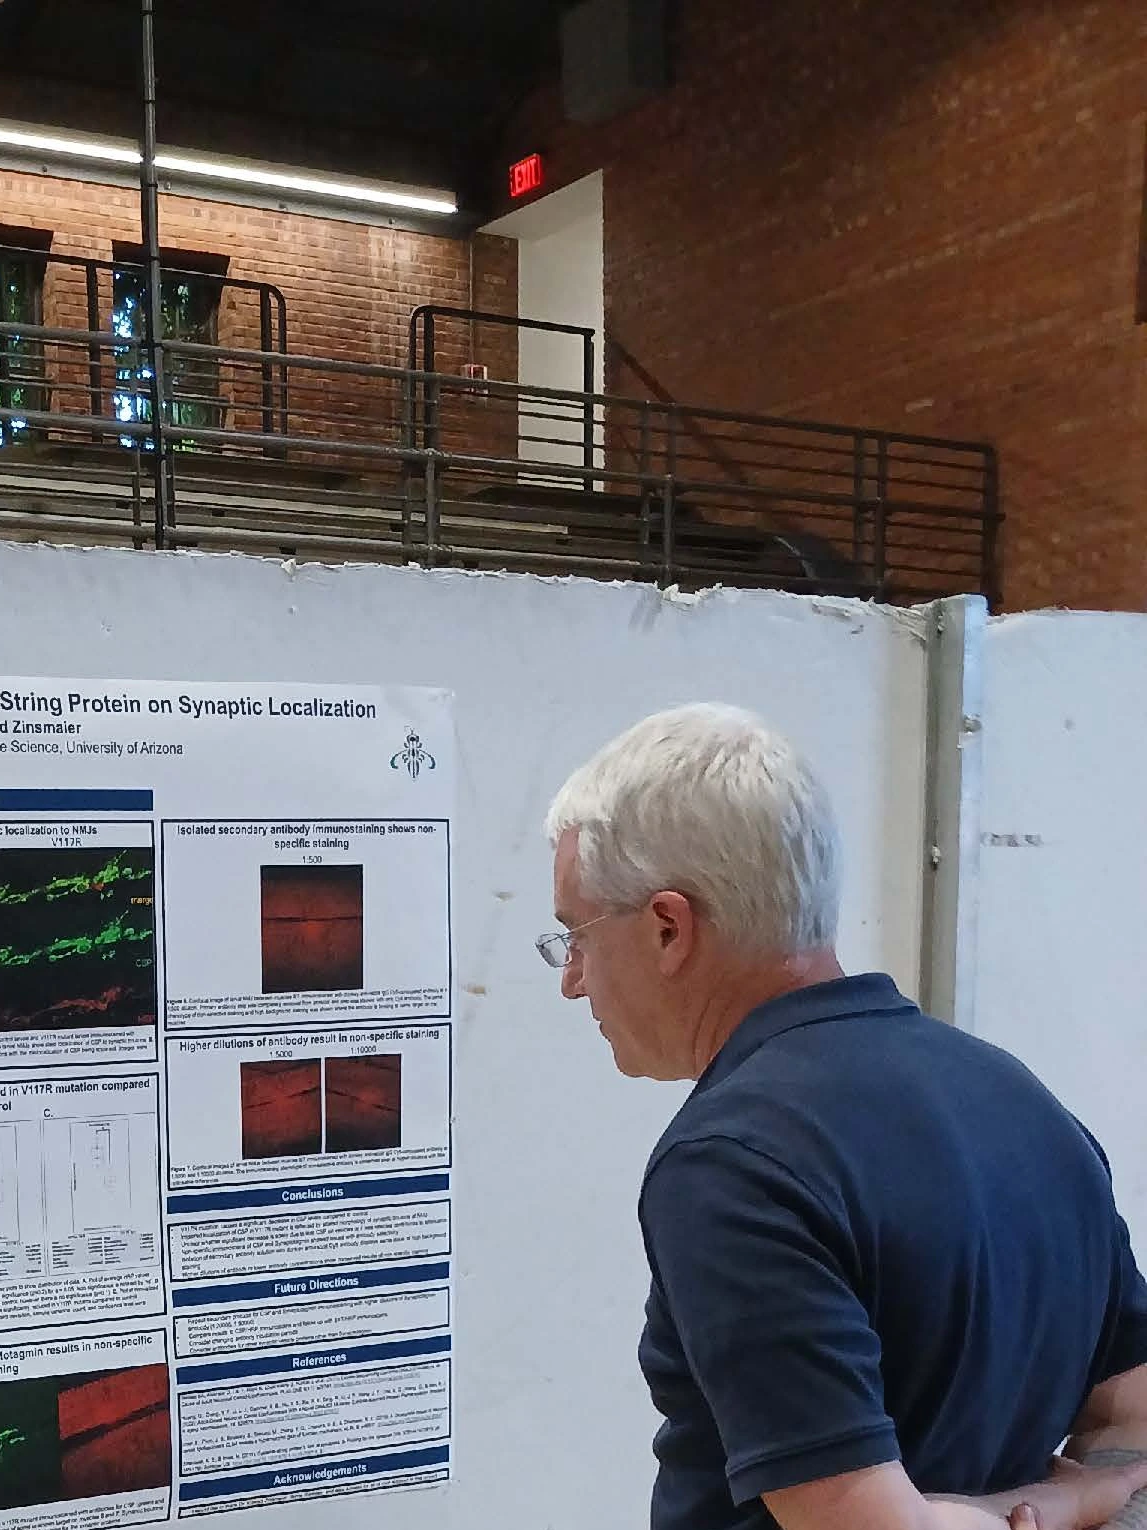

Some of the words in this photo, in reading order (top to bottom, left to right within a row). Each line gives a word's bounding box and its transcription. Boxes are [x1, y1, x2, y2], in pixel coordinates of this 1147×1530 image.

[515, 158, 537, 194] EXIT
[0, 692, 63, 717] String
[68, 693, 141, 714] Protein
[148, 700, 173, 714] on
[178, 695, 263, 719] Synaptic
[269, 697, 377, 719] Localization
[12, 720, 82, 735] Zinsmaier
[11, 740, 63, 756] Science,
[66, 741, 124, 757] University
[127, 741, 139, 755] of
[139, 742, 184, 756] Arizona
[5, 825, 59, 836] localization
[61, 825, 70, 835] to
[72, 825, 98, 836] NMJs
[177, 825, 216, 835] Isolated
[218, 825, 267, 837] secondary
[270, 824, 311, 836] antibody
[312, 824, 386, 836] immunostaining
[387, 824, 416, 834] shows
[417, 825, 437, 834] non-
[52, 837, 82, 848] V117R
[274, 839, 311, 850] specific
[312, 839, 350, 851] staining
[179, 1040, 211, 1053] Higher
[213, 1038, 254, 1050] dilutions
[256, 1037, 266, 1048] of
[268, 1035, 309, 1048] antibody
[310, 1034, 337, 1045] result
[338, 1032, 348, 1043] in
[349, 1030, 404, 1044] non-specific
[405, 1028, 440, 1042] staining
[9, 1085, 19, 1098] in
[22, 1082, 53, 1097] V117R
[55, 1081, 100, 1094] mutation
[101, 1078, 151, 1092] compared
[282, 1186, 344, 1202] Conclusions
[274, 1281, 307, 1295] Future
[309, 1276, 359, 1291] Directions
[46, 1343, 80, 1355] results
[81, 1340, 92, 1351] in
[94, 1335, 153, 1351] non-specific
[293, 1352, 347, 1368] References
[273, 1463, 367, 1486] Acknowledgements
